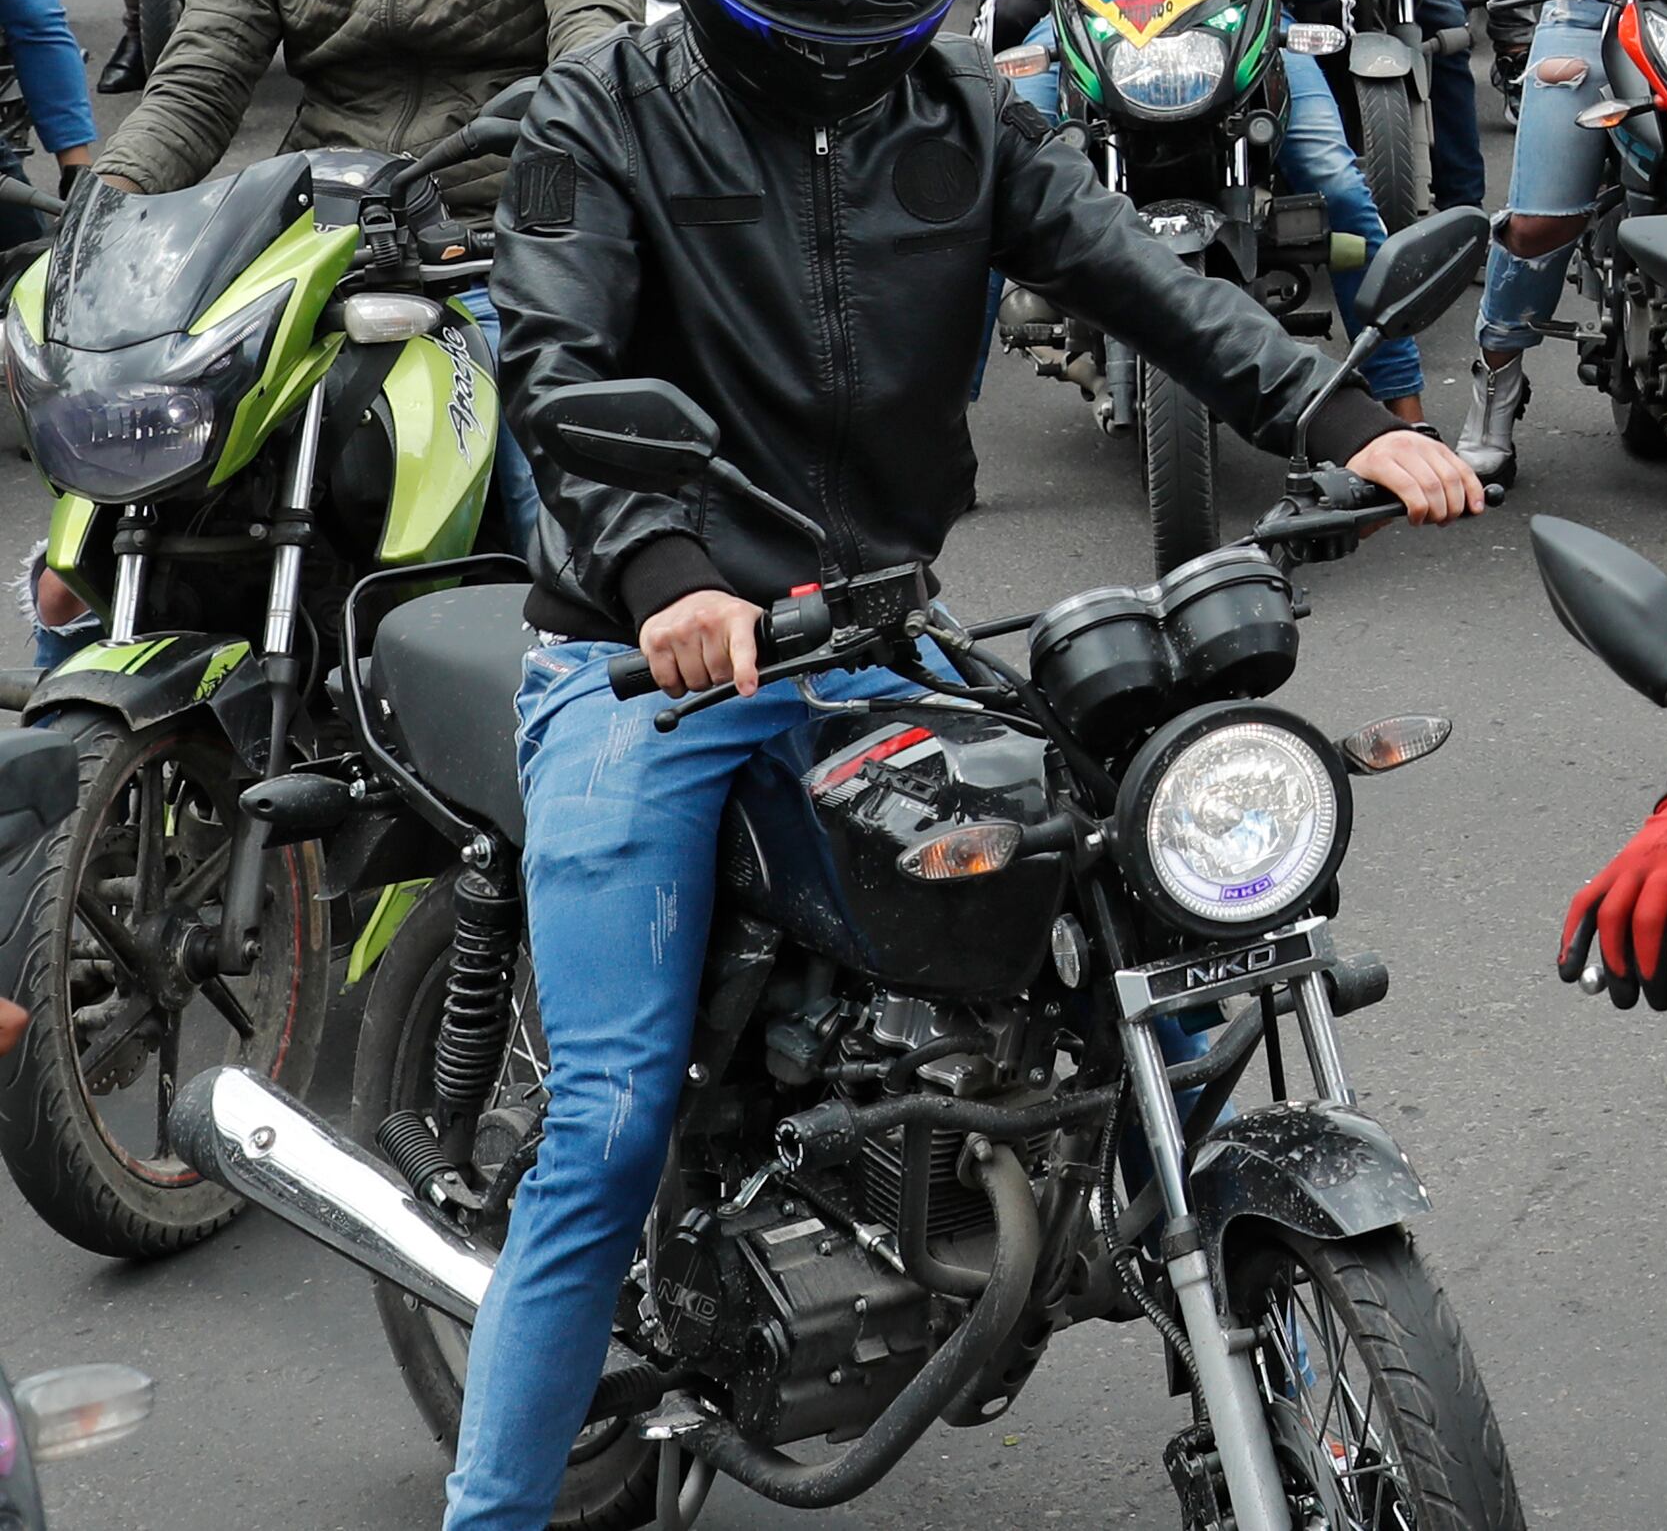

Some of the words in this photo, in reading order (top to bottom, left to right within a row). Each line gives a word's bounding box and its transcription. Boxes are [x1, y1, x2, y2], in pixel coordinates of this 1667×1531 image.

[446, 325, 486, 467] Apache
[1225, 879, 1269, 900] NKD
[1186, 944, 1276, 989] NKD
[656, 1276, 718, 1322] NKD
